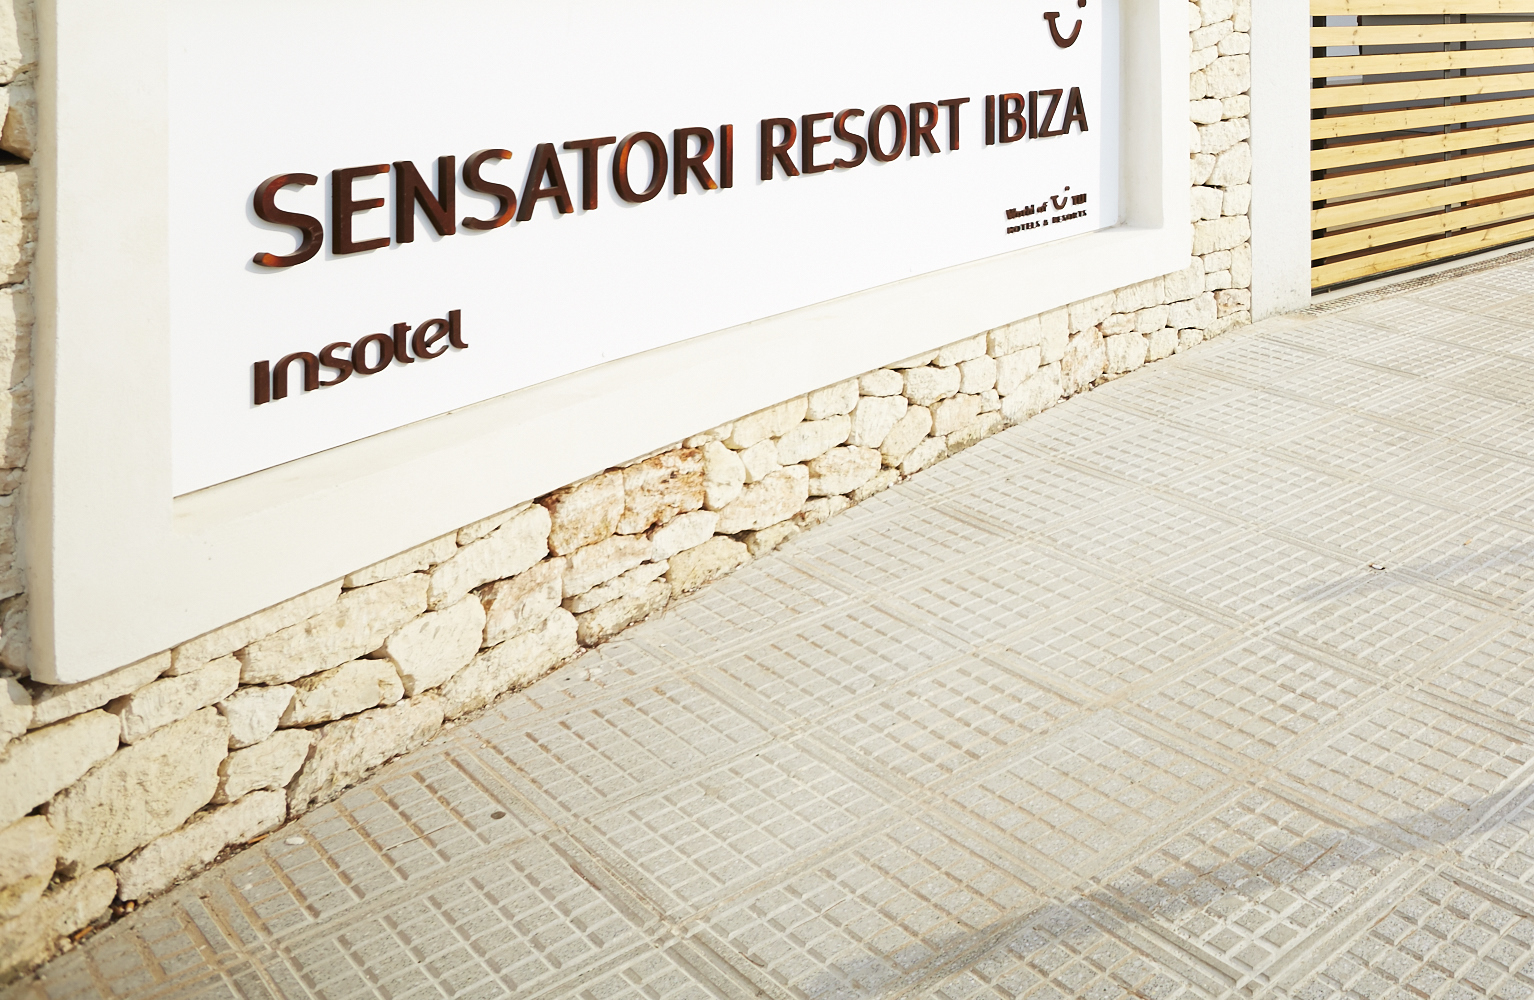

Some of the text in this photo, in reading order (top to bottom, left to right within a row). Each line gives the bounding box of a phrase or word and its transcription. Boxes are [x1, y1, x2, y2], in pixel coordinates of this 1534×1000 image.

[250, 86, 1089, 268] SENSATORI RESORT IBIZA
[1007, 221, 1041, 234] HOTELS
[1052, 210, 1087, 223] RESORTS
